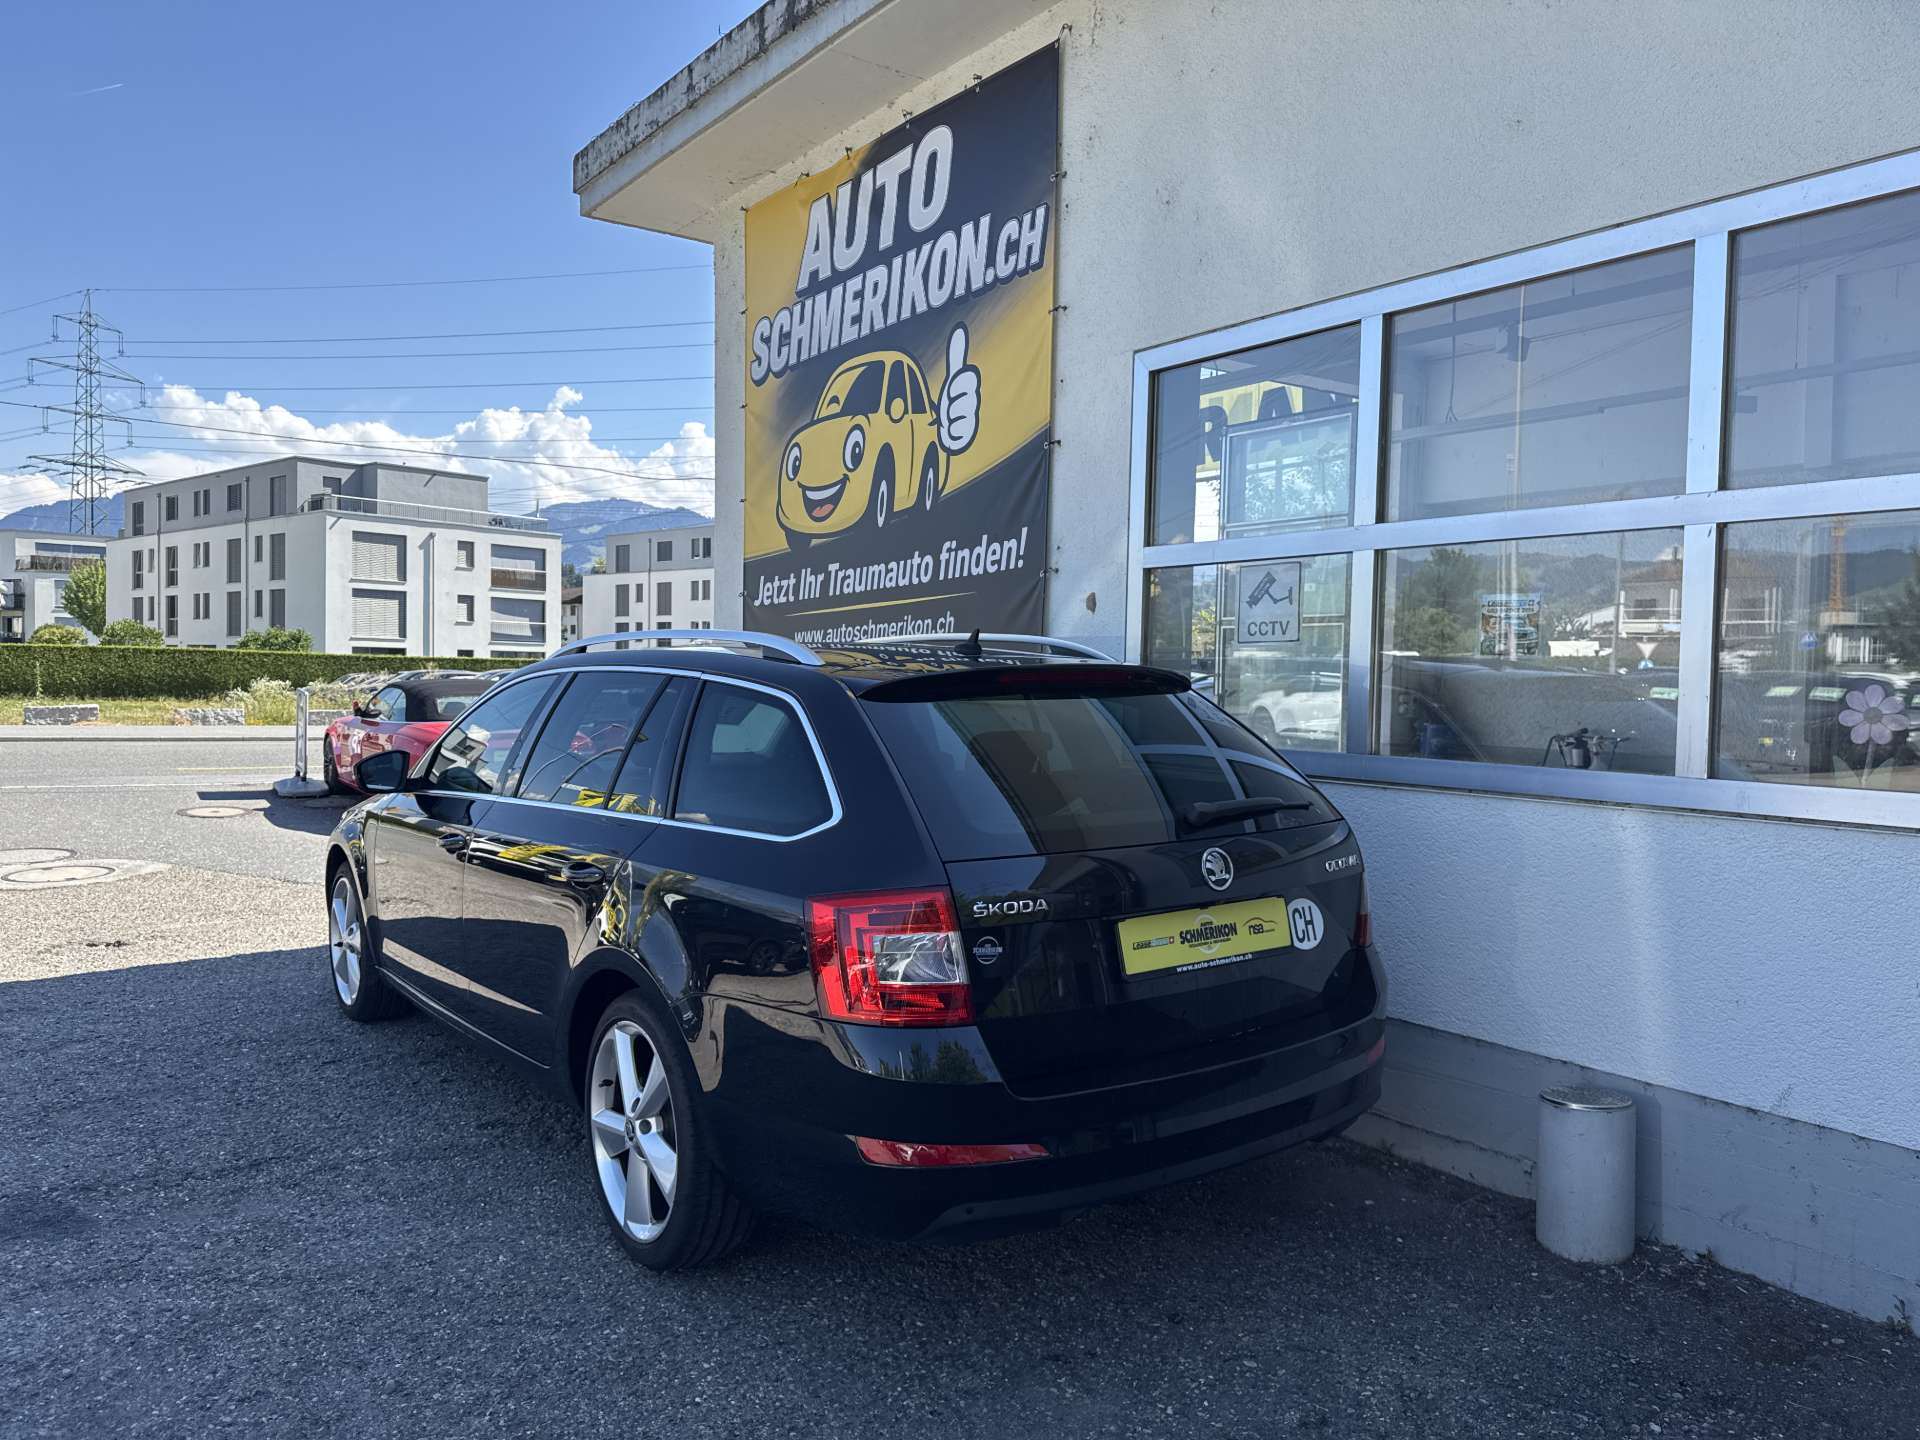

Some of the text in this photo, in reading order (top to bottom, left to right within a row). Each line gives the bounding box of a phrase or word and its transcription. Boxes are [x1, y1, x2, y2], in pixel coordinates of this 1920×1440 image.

[796, 124, 953, 292] AUTO
[751, 202, 1049, 382] SCHMERIKON.CH
[753, 526, 1028, 607] Jetzt Ihr Traumauto finden!
[794, 611, 955, 643] www.autoschmerikon.ch
[1247, 620, 1290, 637] CCTV
[973, 899, 1049, 918] ŠKODA
[1291, 905, 1317, 944] CH
[1179, 922, 1238, 945] SCHMERIKON
